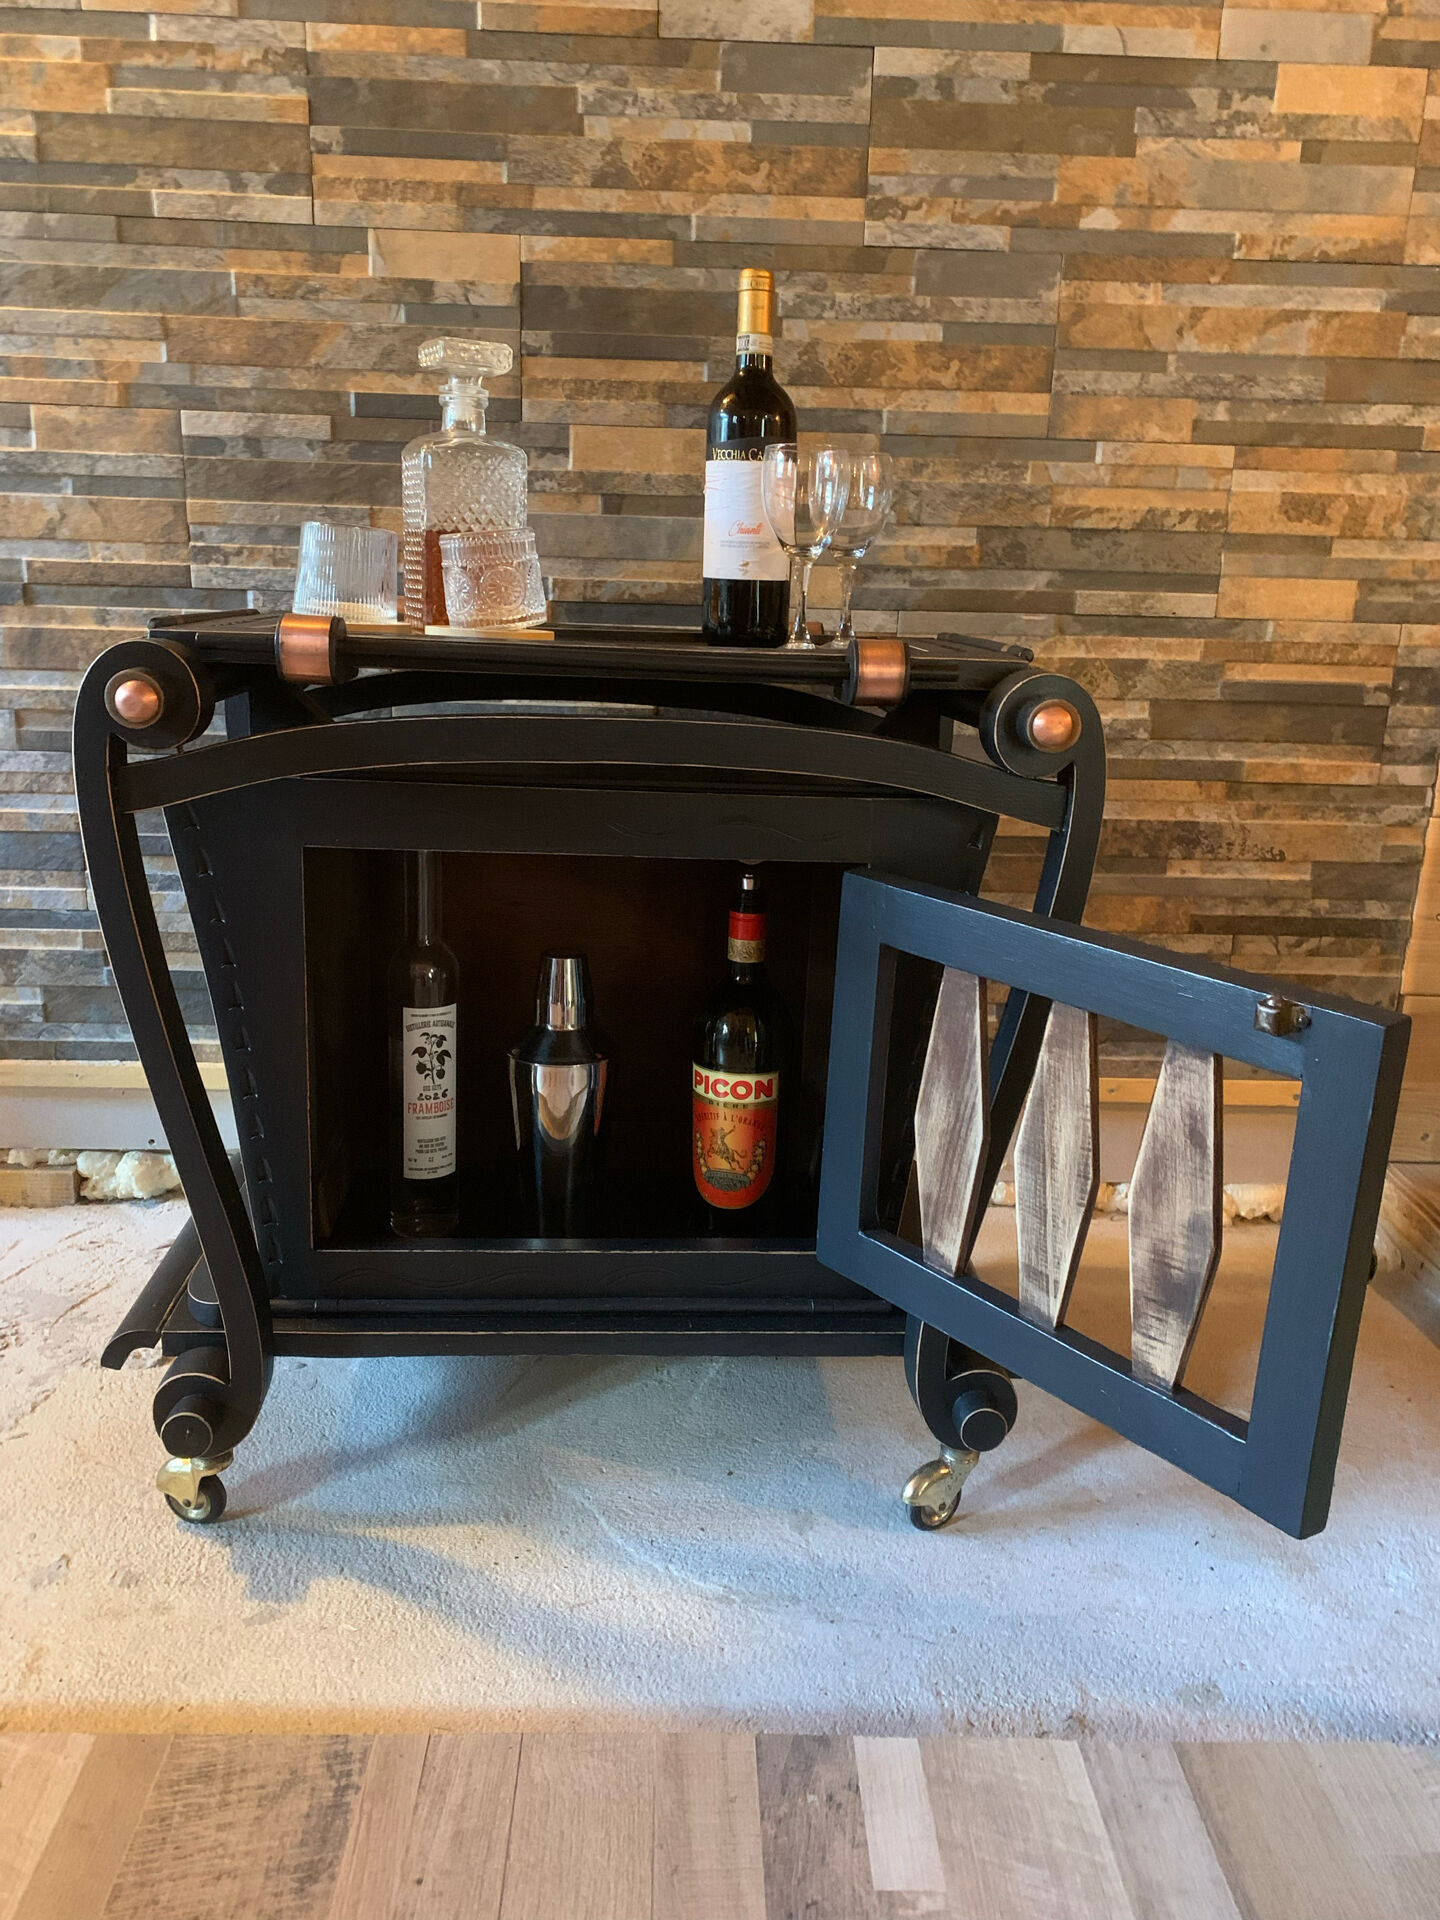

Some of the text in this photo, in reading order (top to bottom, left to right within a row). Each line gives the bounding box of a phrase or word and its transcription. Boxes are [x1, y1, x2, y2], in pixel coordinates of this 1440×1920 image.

[713, 447, 765, 461] VECCHIA CA
[694, 1069, 773, 1100] PICON
[407, 1098, 454, 1114] FRAMBOISE
